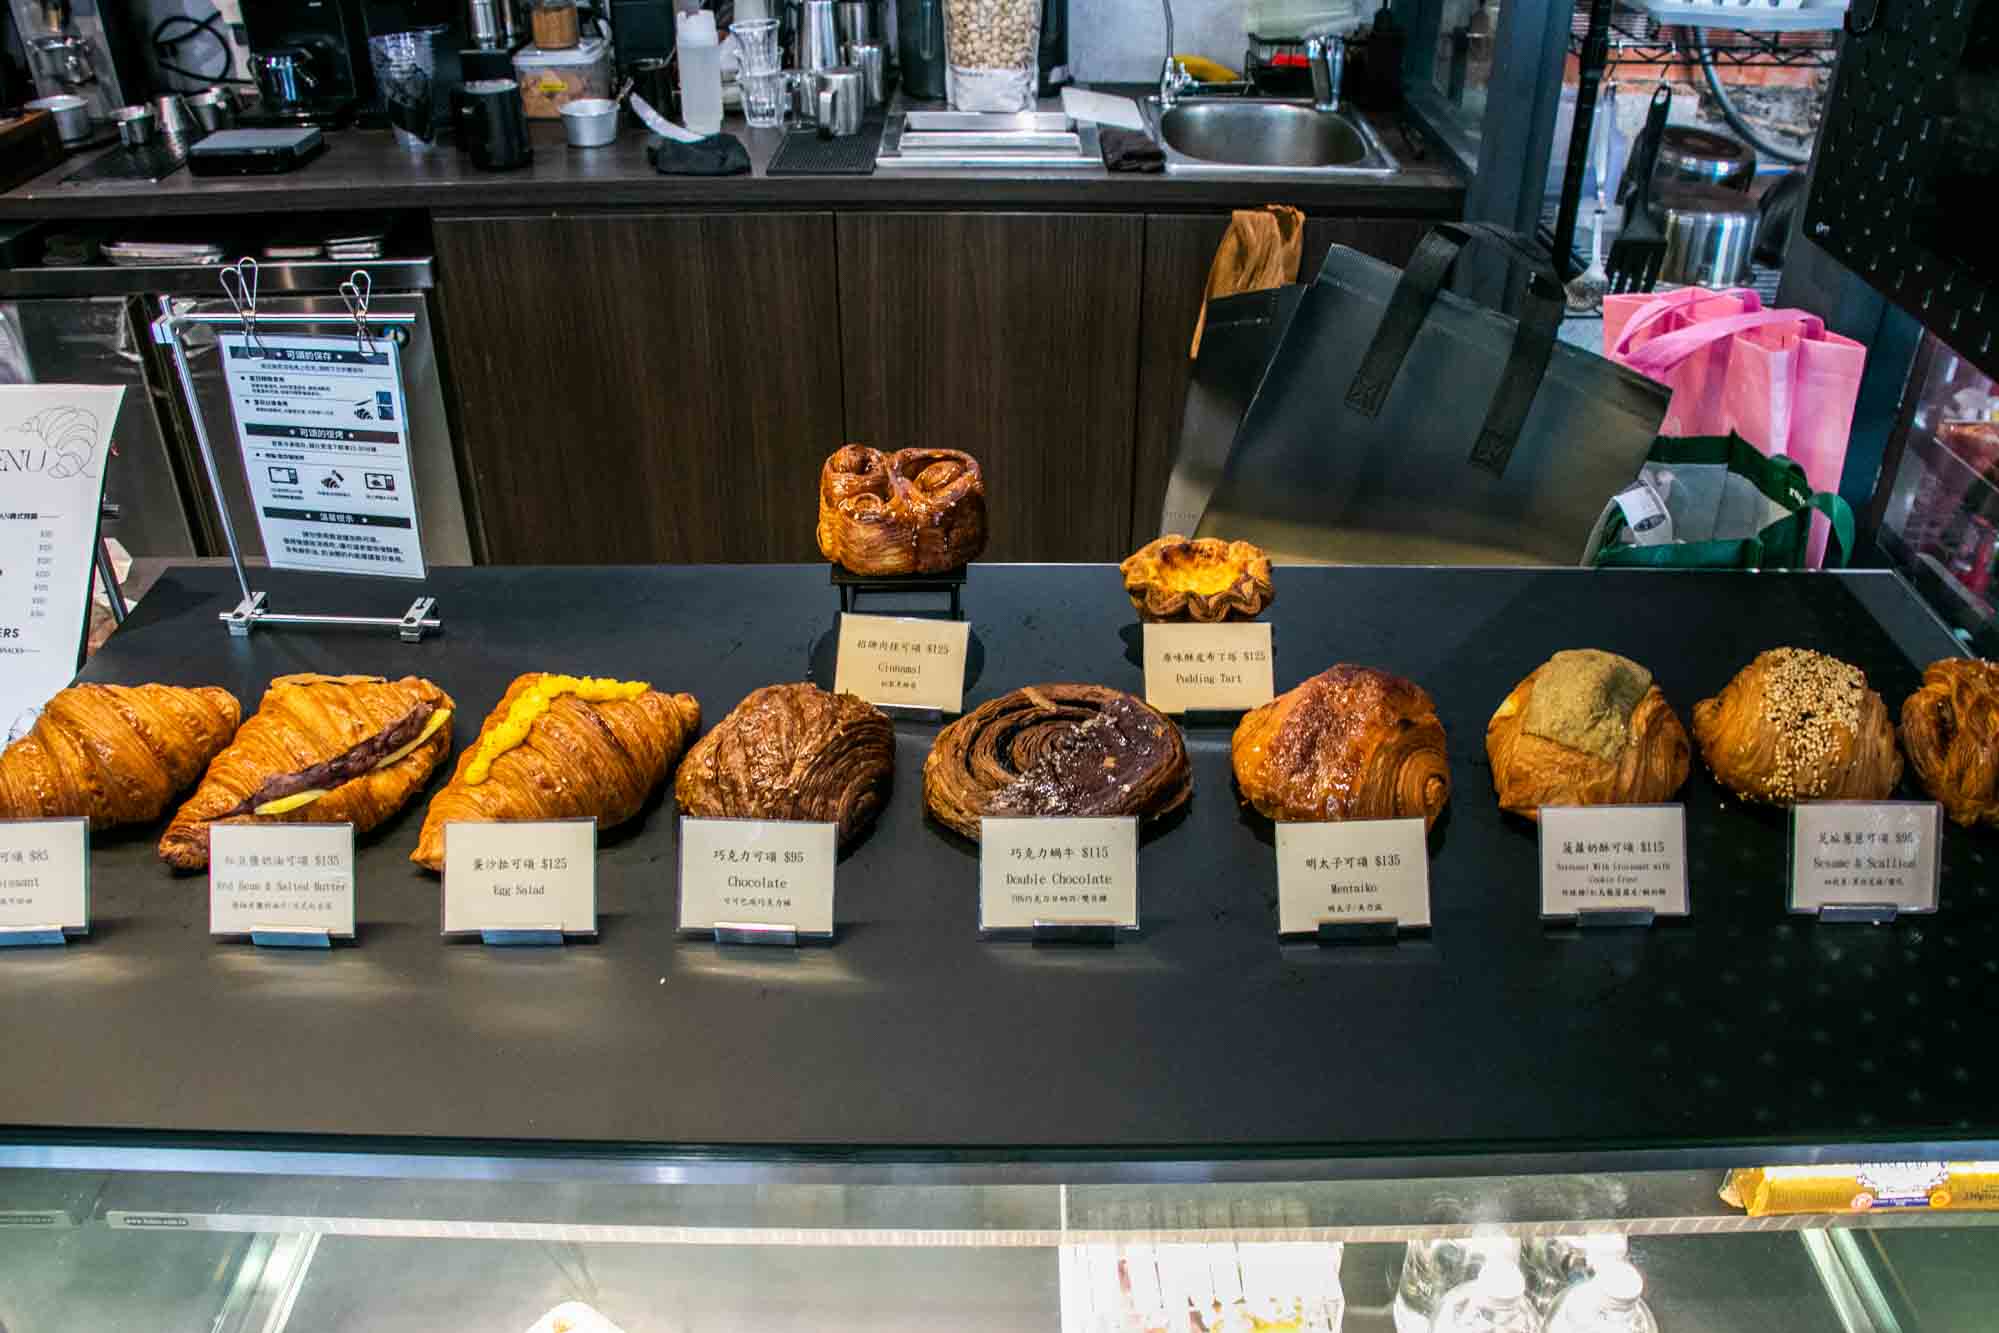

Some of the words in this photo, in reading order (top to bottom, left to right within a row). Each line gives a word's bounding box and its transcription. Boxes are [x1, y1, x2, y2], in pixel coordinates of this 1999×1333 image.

[927, 643, 950, 655] $125
[1175, 672, 1215, 684] Pudding
[1219, 672, 1241, 683] Tart
[1008, 847, 1074, 860] 巧克力蝸牛
[1081, 846, 1109, 859] $115
[1640, 841, 1664, 853] $115
[713, 849, 777, 863] 巧克力可頌
[783, 850, 804, 863] $95
[1304, 856, 1368, 870] 明太子可頌
[1375, 854, 1401, 867] $135
[472, 858, 536, 871] 蛋沙拉可頌
[540, 857, 568, 870] $125
[727, 875, 789, 888] Chocolate
[1006, 872, 1047, 885] Double
[1052, 872, 1113, 885] Chocolate
[277, 879, 309, 891] Salted
[313, 879, 345, 892] Butter
[493, 884, 511, 896] Egg
[515, 884, 544, 895] Salad
